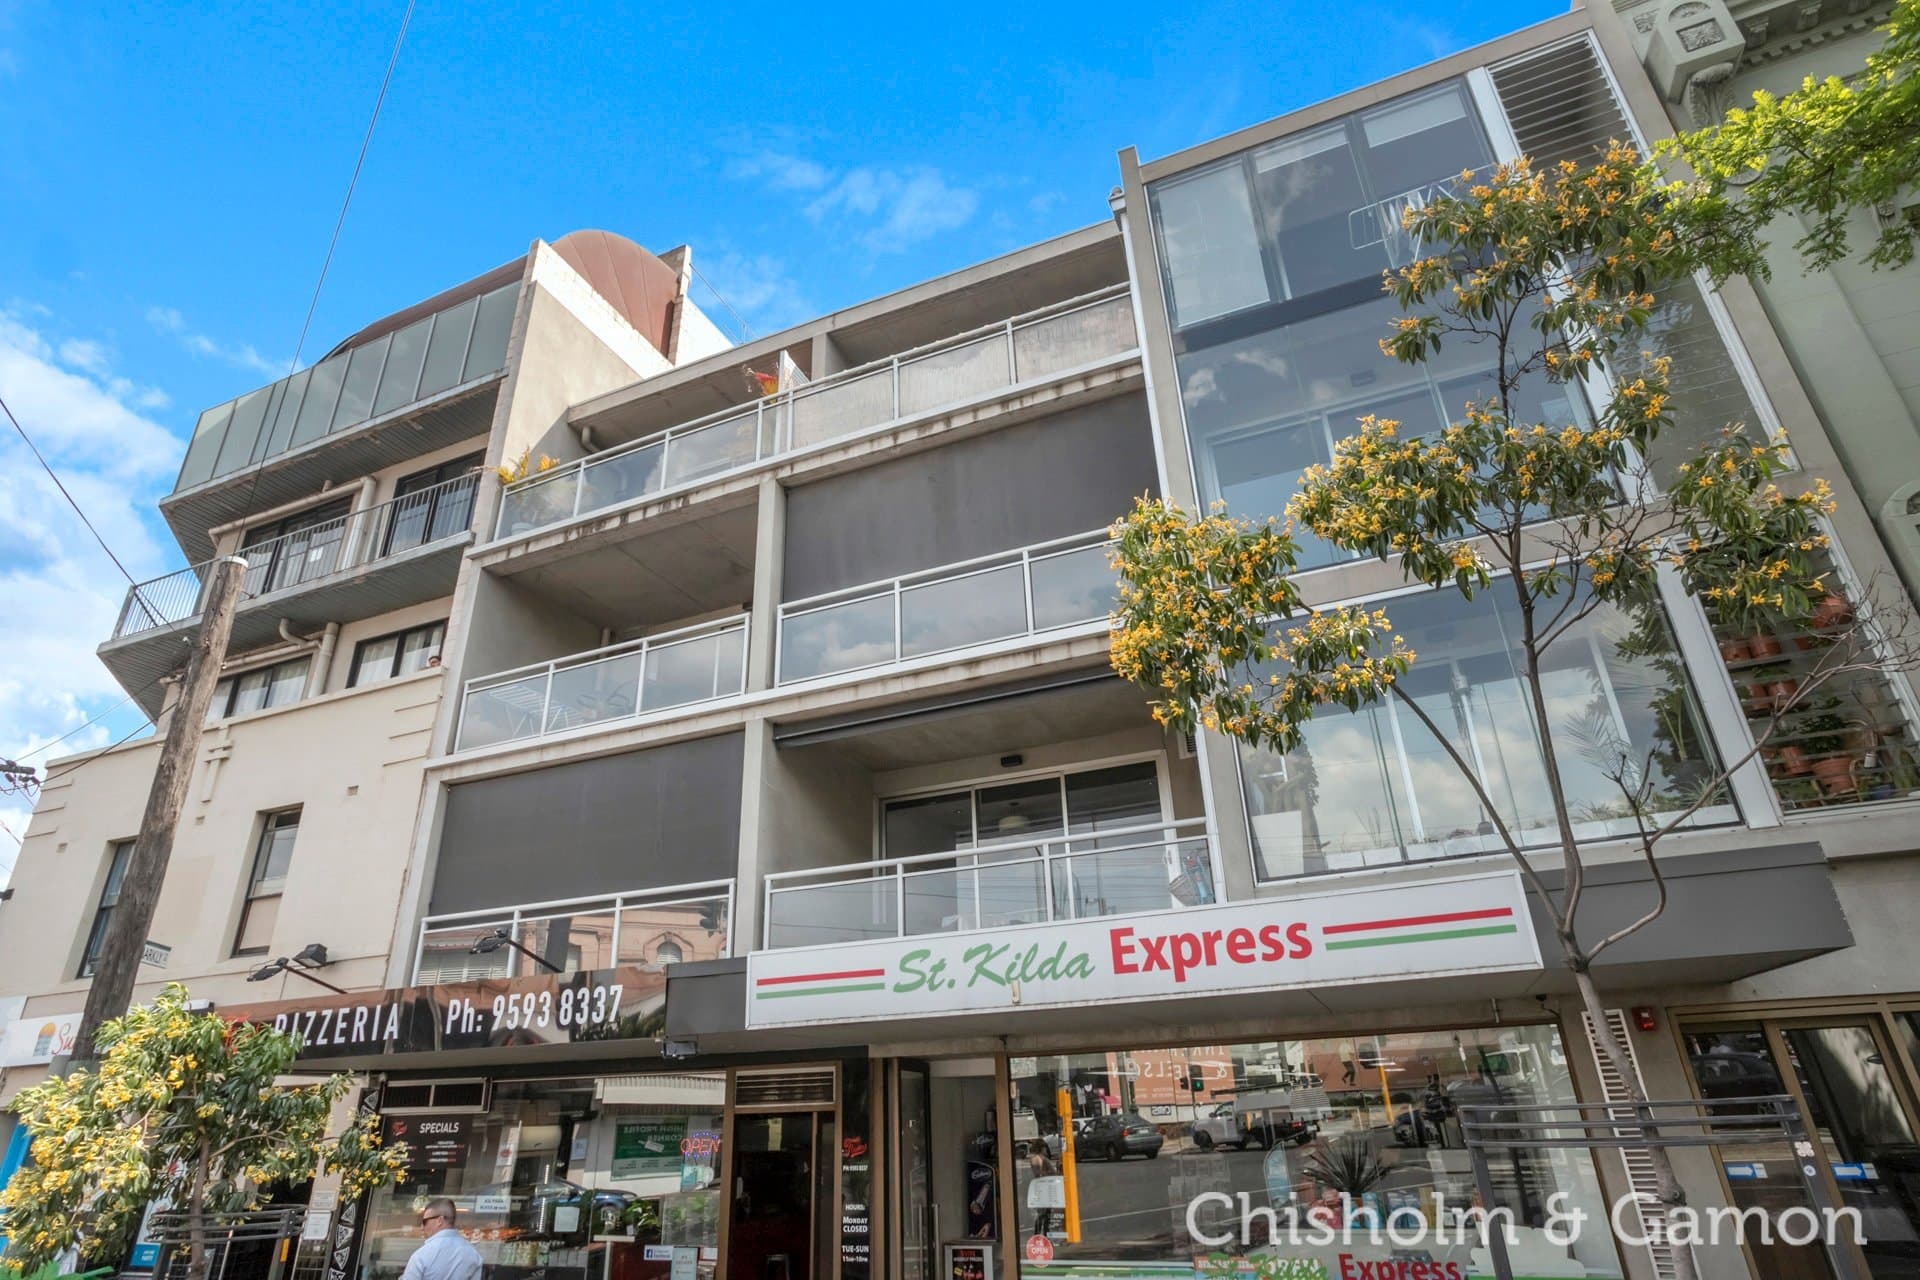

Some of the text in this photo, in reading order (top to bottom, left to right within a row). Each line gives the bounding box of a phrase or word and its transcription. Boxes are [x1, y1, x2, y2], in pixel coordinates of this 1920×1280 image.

[963, 941, 1096, 988] Kilda
[1110, 922, 1313, 983] Express
[446, 984, 623, 1034] Ph: 9593 8337
[274, 1002, 399, 1047] PIZZERIA
[419, 1122, 460, 1134] SPECIALS
[680, 1138, 720, 1154] OPEN
[843, 1225, 868, 1233] CLOSED
[842, 1245, 869, 1253] TUE-SUN
[1338, 1253, 1461, 1280] Express
